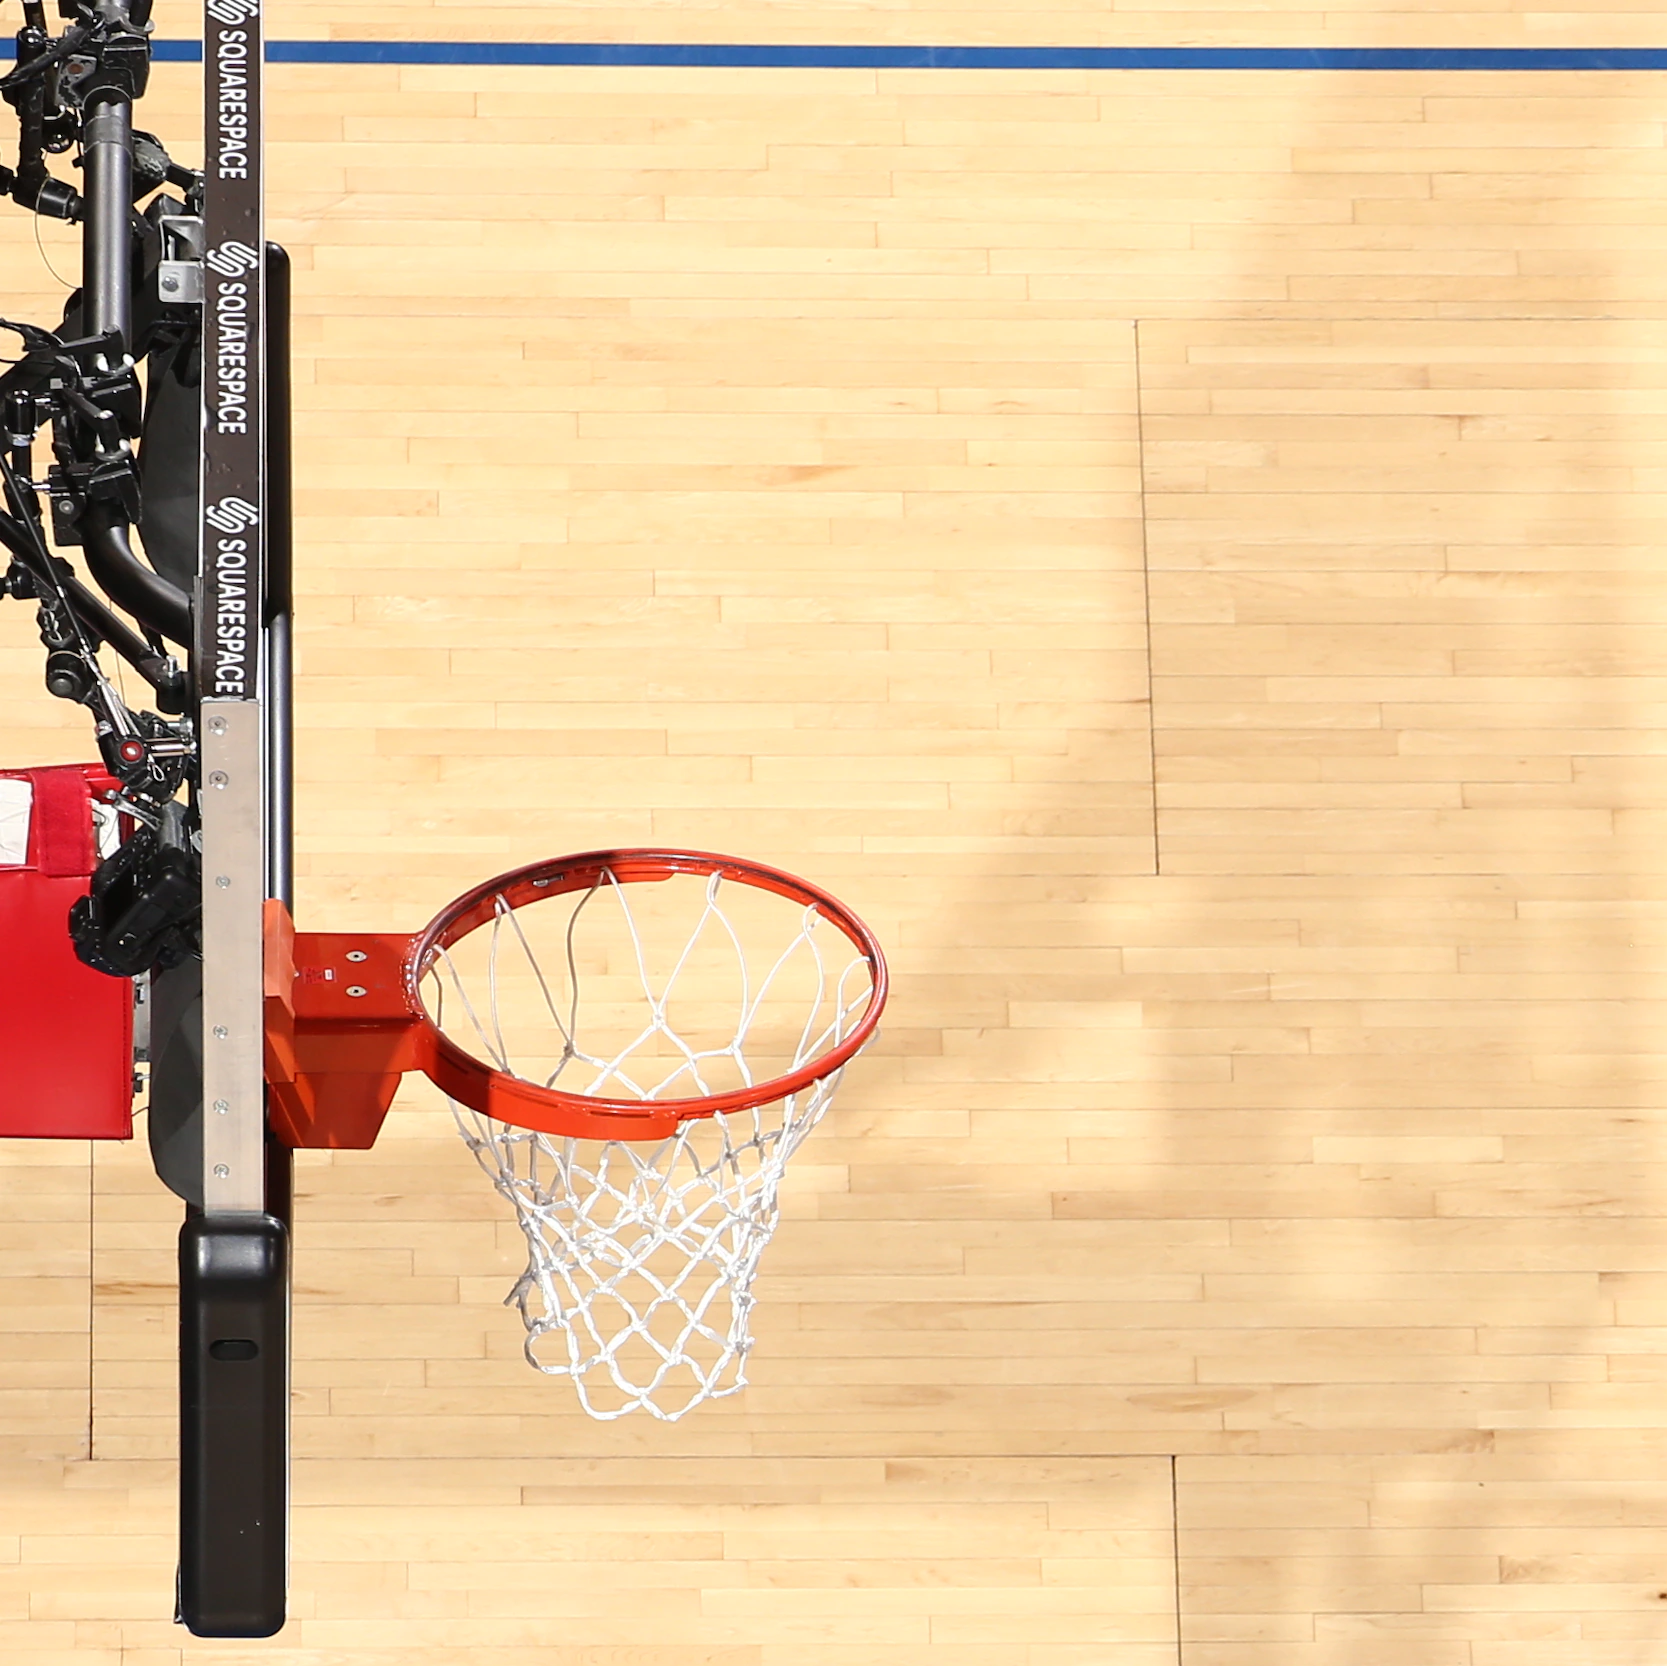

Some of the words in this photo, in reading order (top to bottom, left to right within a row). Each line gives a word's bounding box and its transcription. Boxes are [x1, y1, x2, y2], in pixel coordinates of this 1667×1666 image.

[217, 30, 248, 179] SQUARESPACE
[216, 282, 248, 435] SQUARESPACE
[215, 537, 246, 696] SQUARESPACE
